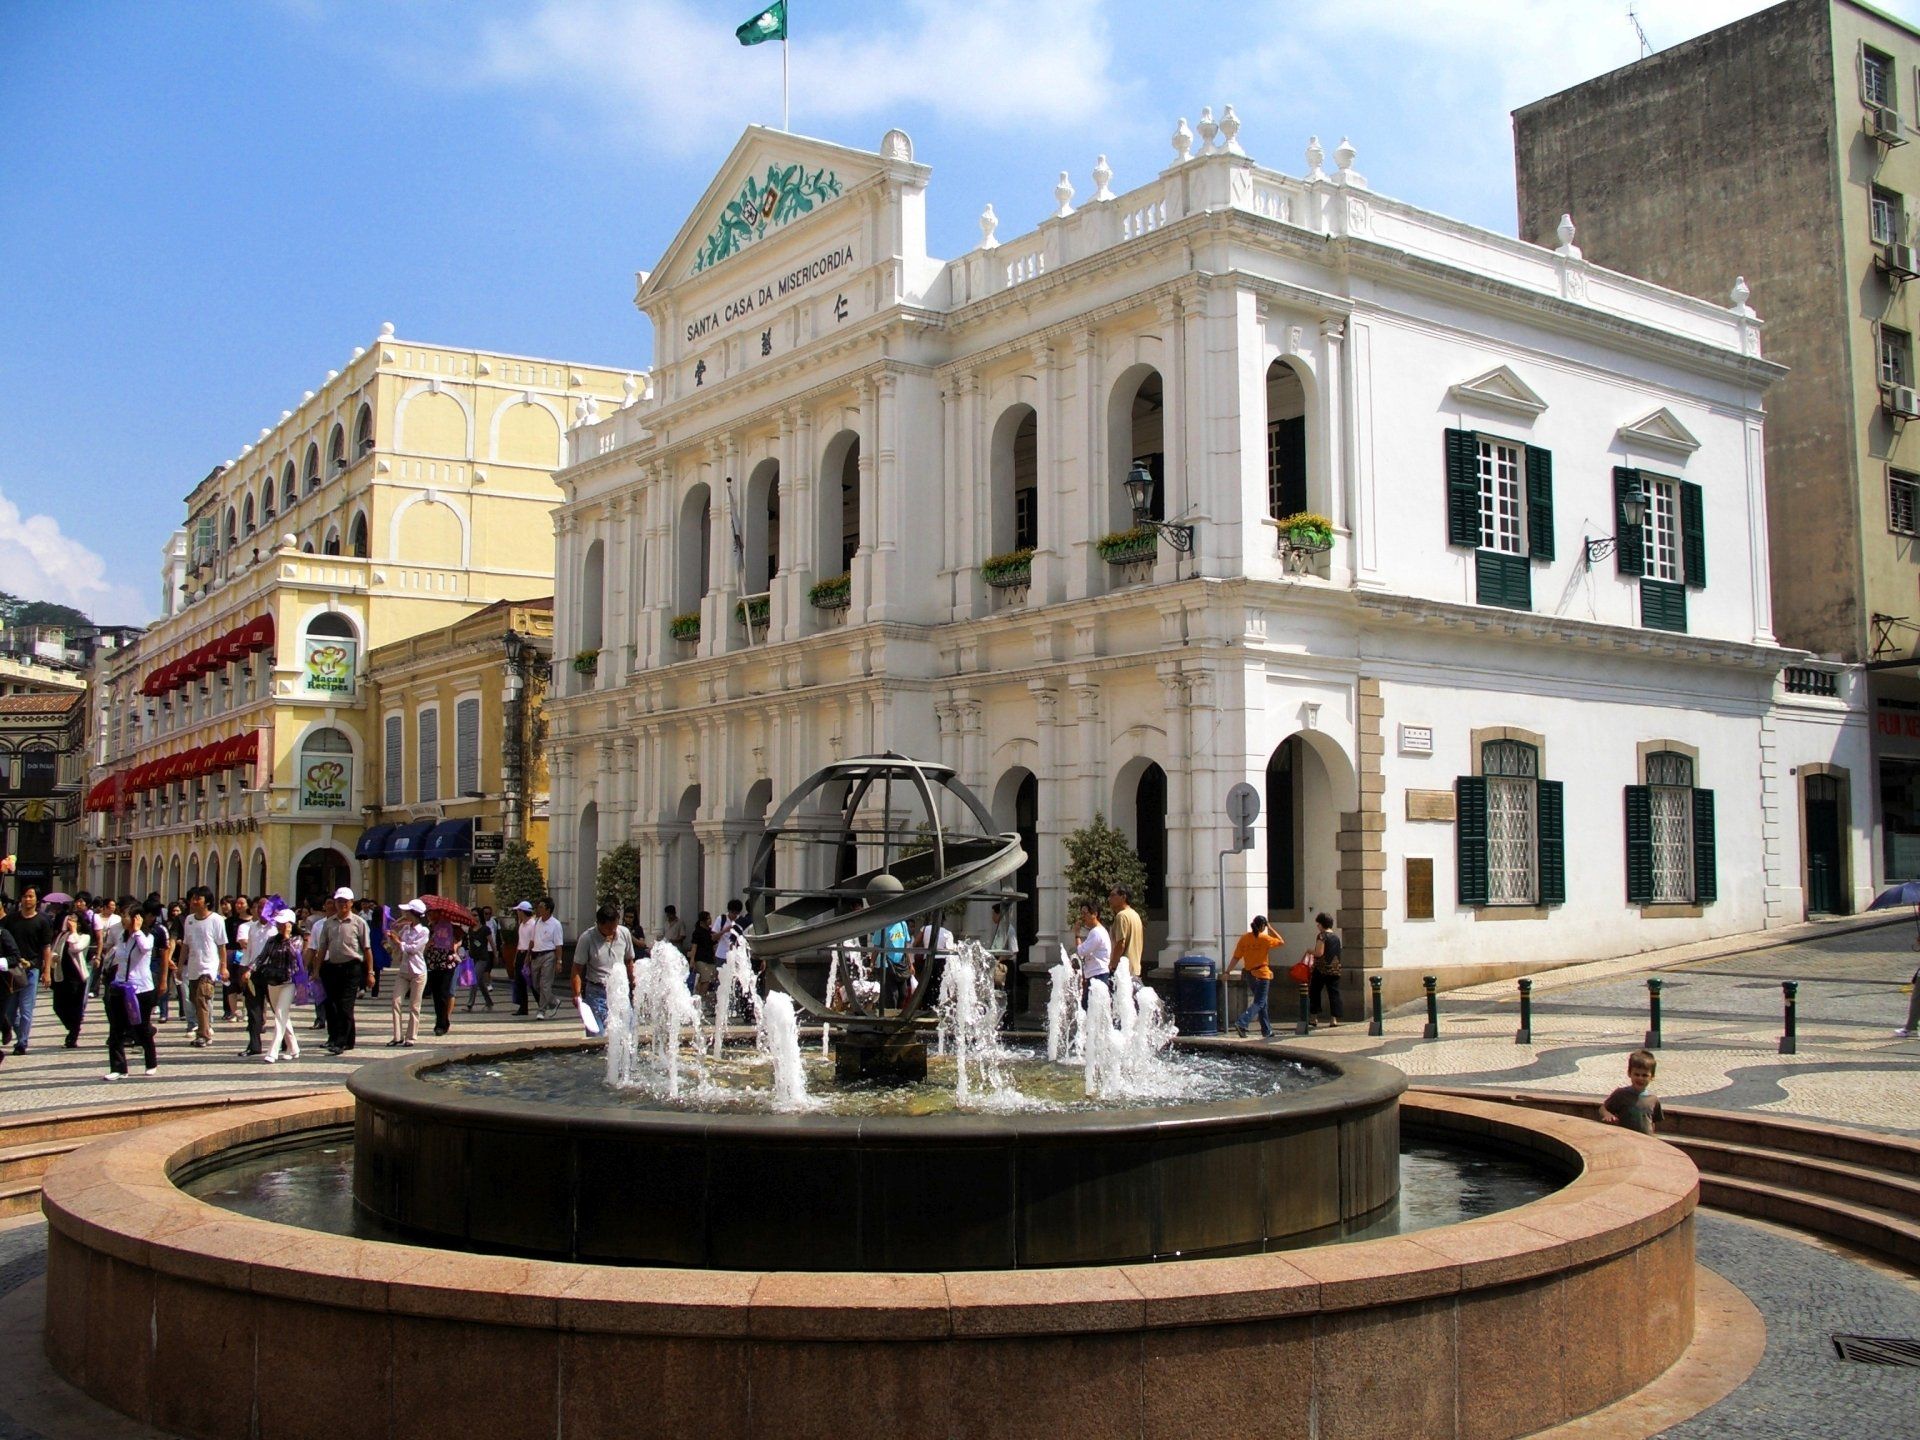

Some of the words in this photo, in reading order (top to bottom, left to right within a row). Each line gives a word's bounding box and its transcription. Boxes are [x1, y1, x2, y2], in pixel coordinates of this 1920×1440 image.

[687, 312, 719, 342] SANTA
[725, 295, 754, 322] CASA
[758, 285, 774, 307] DA
[778, 244, 854, 297] MISERICORDIA
[311, 674, 346, 684] Macau
[307, 681, 349, 692] Recipes
[308, 790, 343, 800] Macau
[304, 798, 347, 809] Recipes
